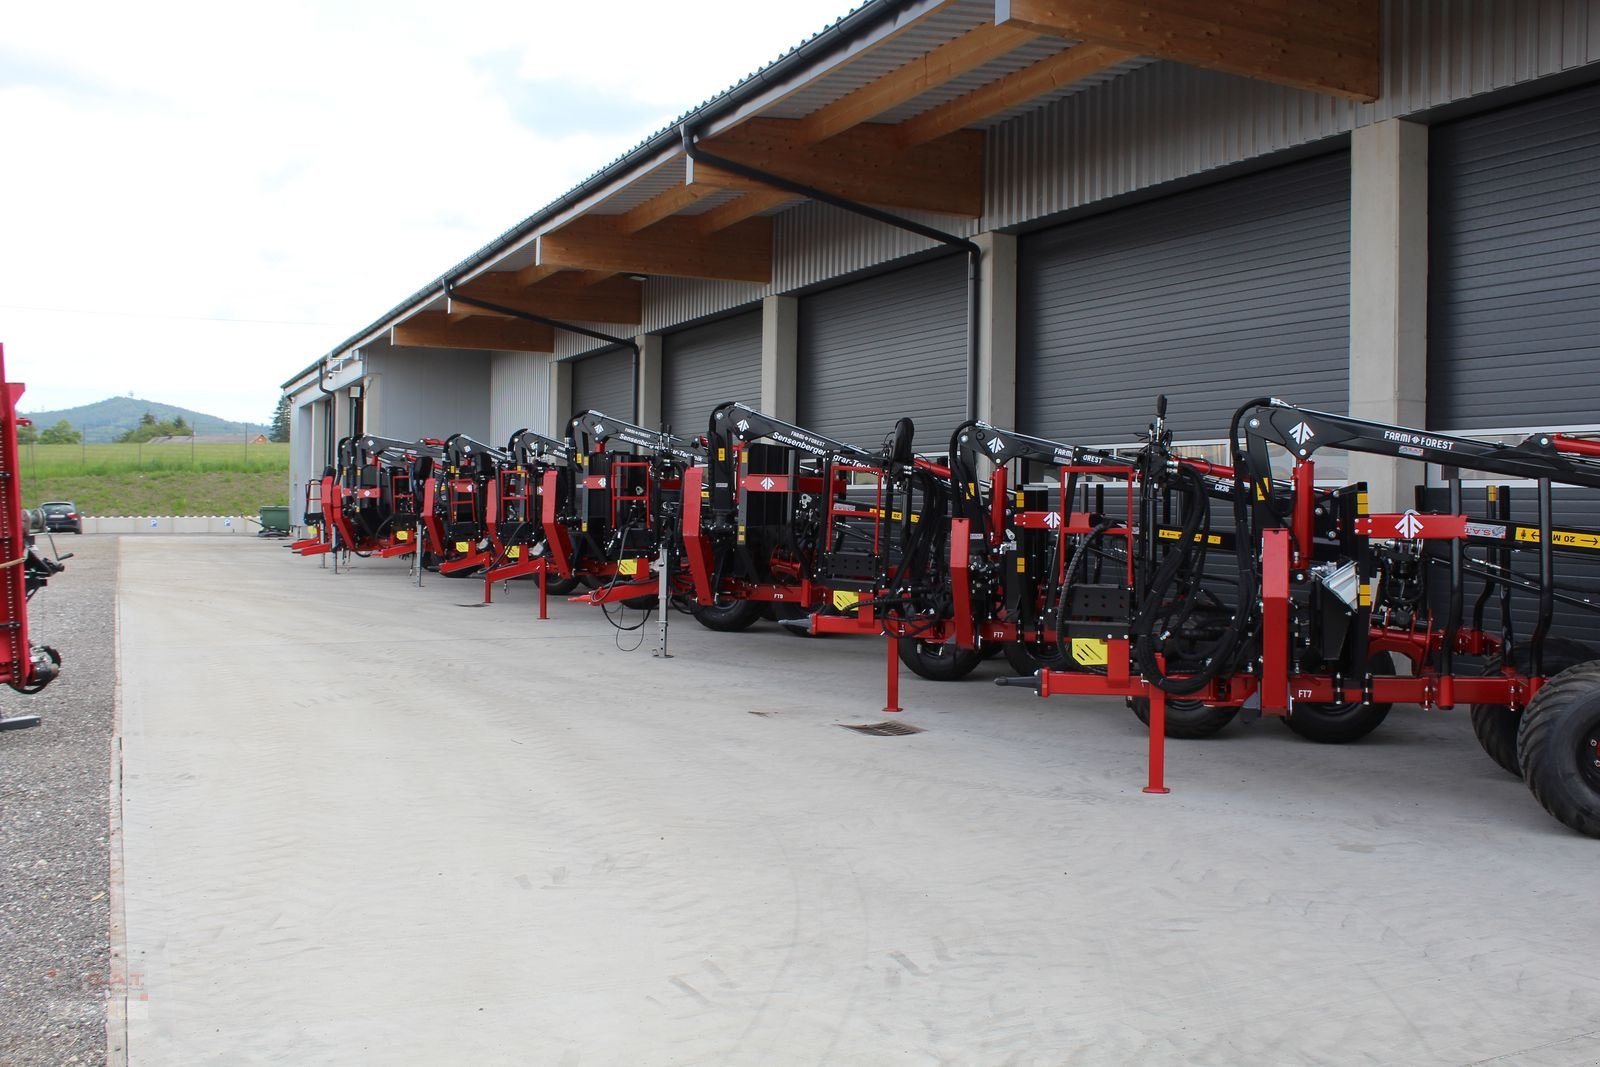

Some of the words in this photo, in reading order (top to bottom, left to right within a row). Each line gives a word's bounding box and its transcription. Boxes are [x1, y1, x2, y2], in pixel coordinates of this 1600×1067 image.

[1384, 431, 1411, 444] FARMI
[1420, 437, 1454, 451] FOREST
[1298, 689, 1312, 698] FT7
